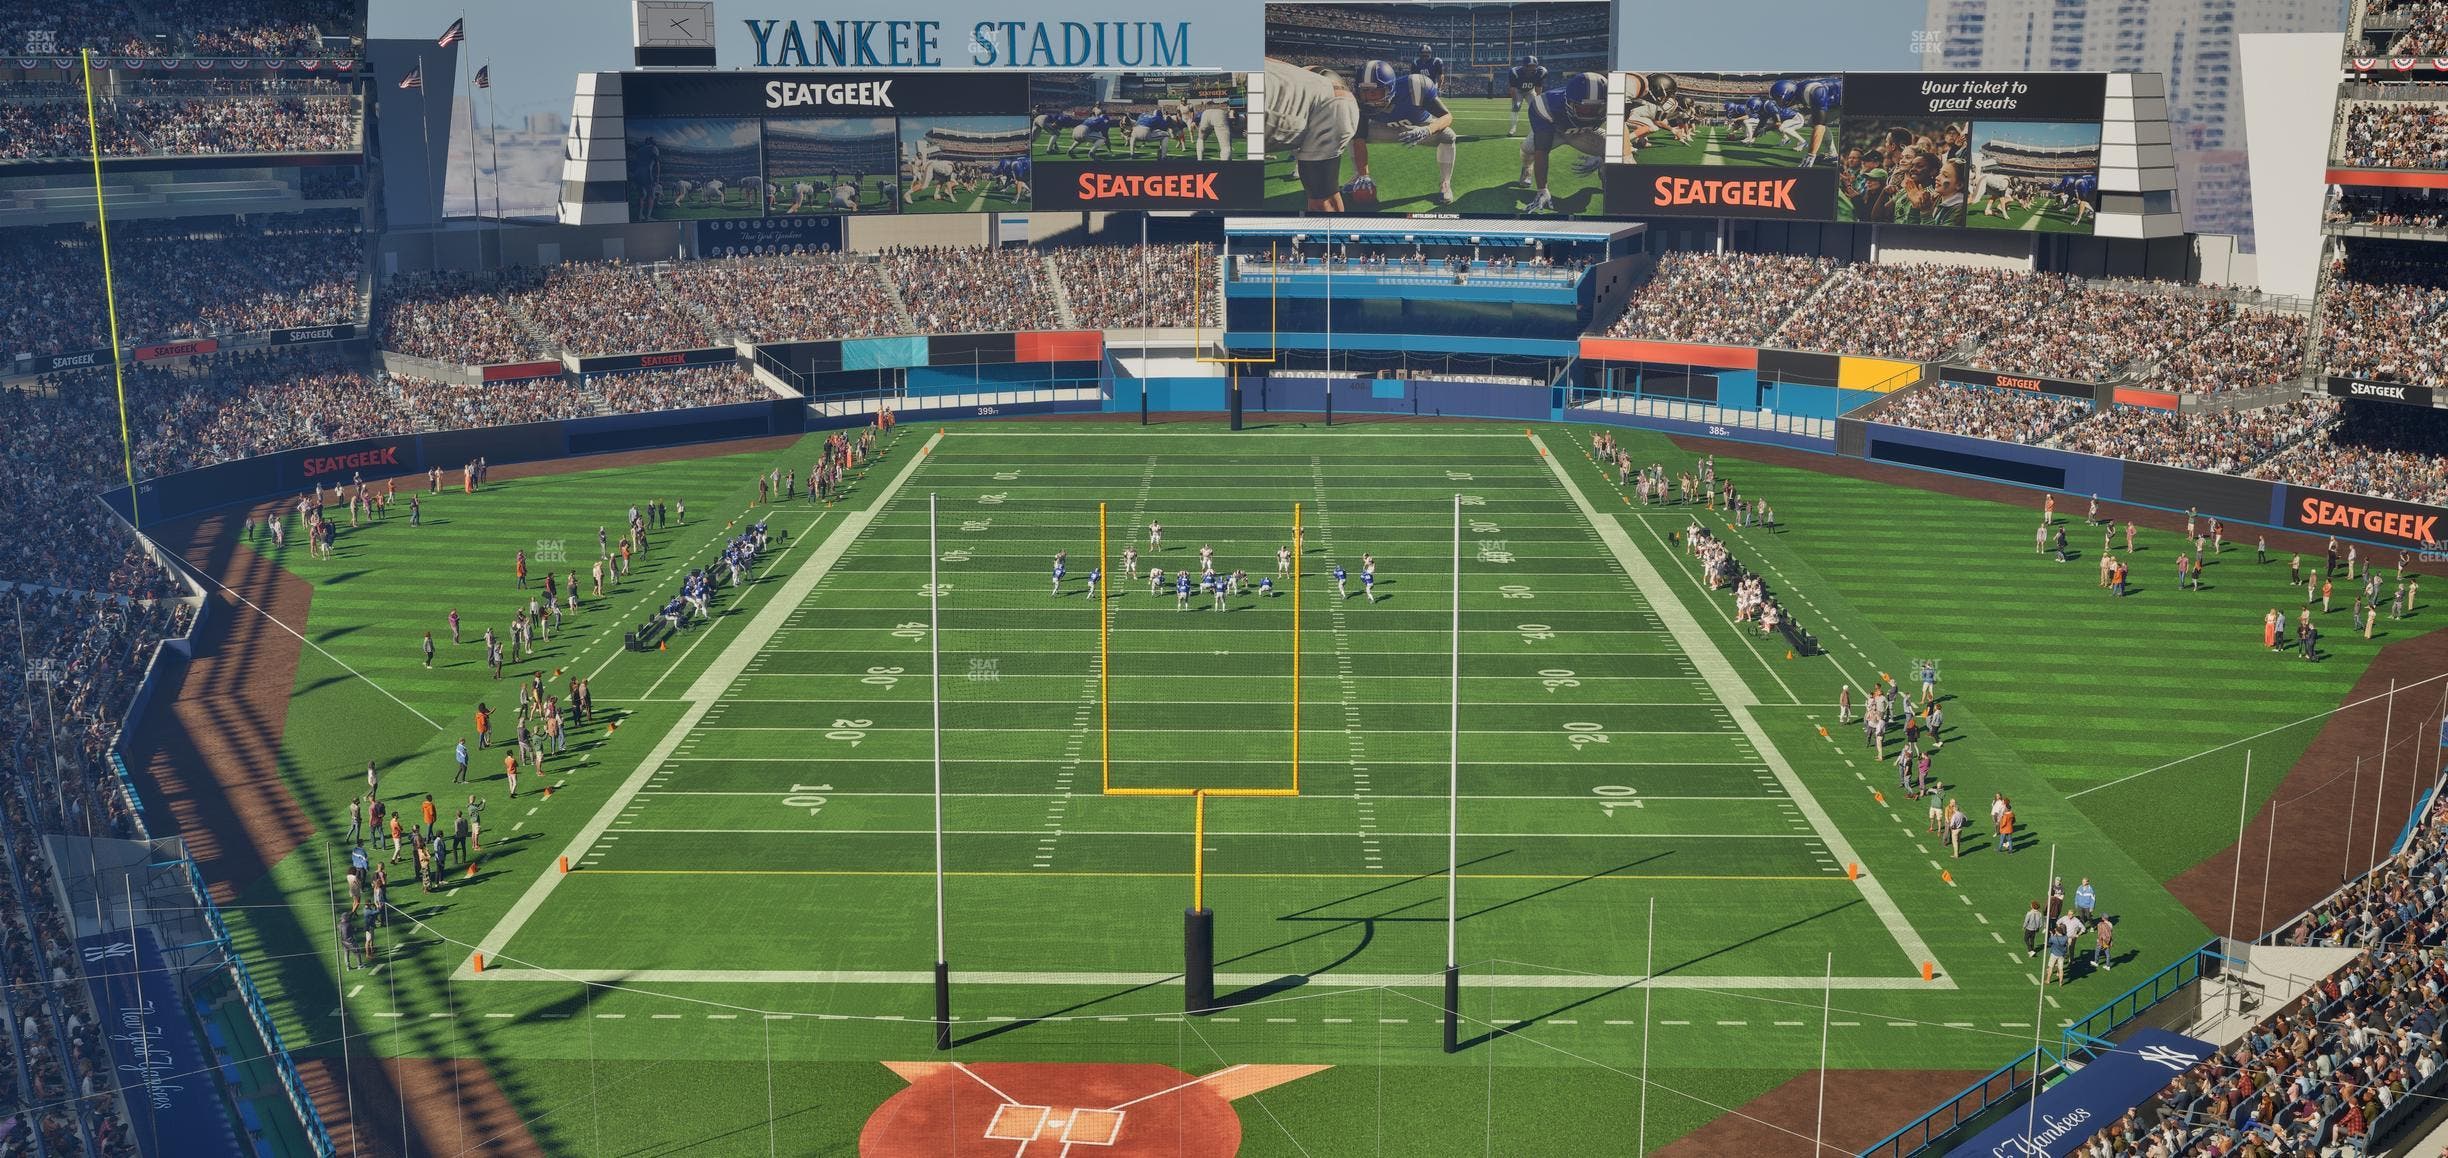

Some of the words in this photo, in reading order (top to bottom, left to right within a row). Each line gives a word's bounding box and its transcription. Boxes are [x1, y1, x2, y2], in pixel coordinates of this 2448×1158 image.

[744, 20, 941, 67] YANKEE
[975, 21, 1192, 67] STADIUM
[766, 80, 894, 108] SEATGEEK
[1921, 80, 1959, 95] Your
[1962, 80, 2009, 94] ticket
[2011, 81, 2028, 94] to
[1929, 96, 1973, 112] great
[1975, 96, 2017, 109] seats
[1079, 172, 1219, 200] SEATGEEK
[1654, 175, 1798, 211] SEATGEEK
[290, 328, 334, 342] SEATGEEK
[154, 343, 198, 357] SEATGEEK
[641, 353, 685, 367] SEATGEEK
[52, 353, 95, 369] SEATGEEK
[1996, 375, 2041, 391] SEATGEEK
[2351, 382, 2405, 400] SEATGEEK
[303, 446, 399, 477] SEATGEEK
[2301, 497, 2439, 545] SEATGEEK
[1499, 585, 1535, 599] 50
[890, 621, 929, 637] 40
[1517, 624, 1555, 640] 40
[860, 666, 904, 685] 30
[1537, 669, 1581, 687] 30
[824, 719, 873, 740] 20
[1563, 722, 1611, 743] 20
[782, 783, 834, 807] 10
[1591, 785, 1644, 808] 10
[120, 1000, 156, 1028] New
[109, 1026, 170, 1057] York
[118, 1056, 184, 1110] Yankees
[2001, 1107, 2092, 1158] Yankees
